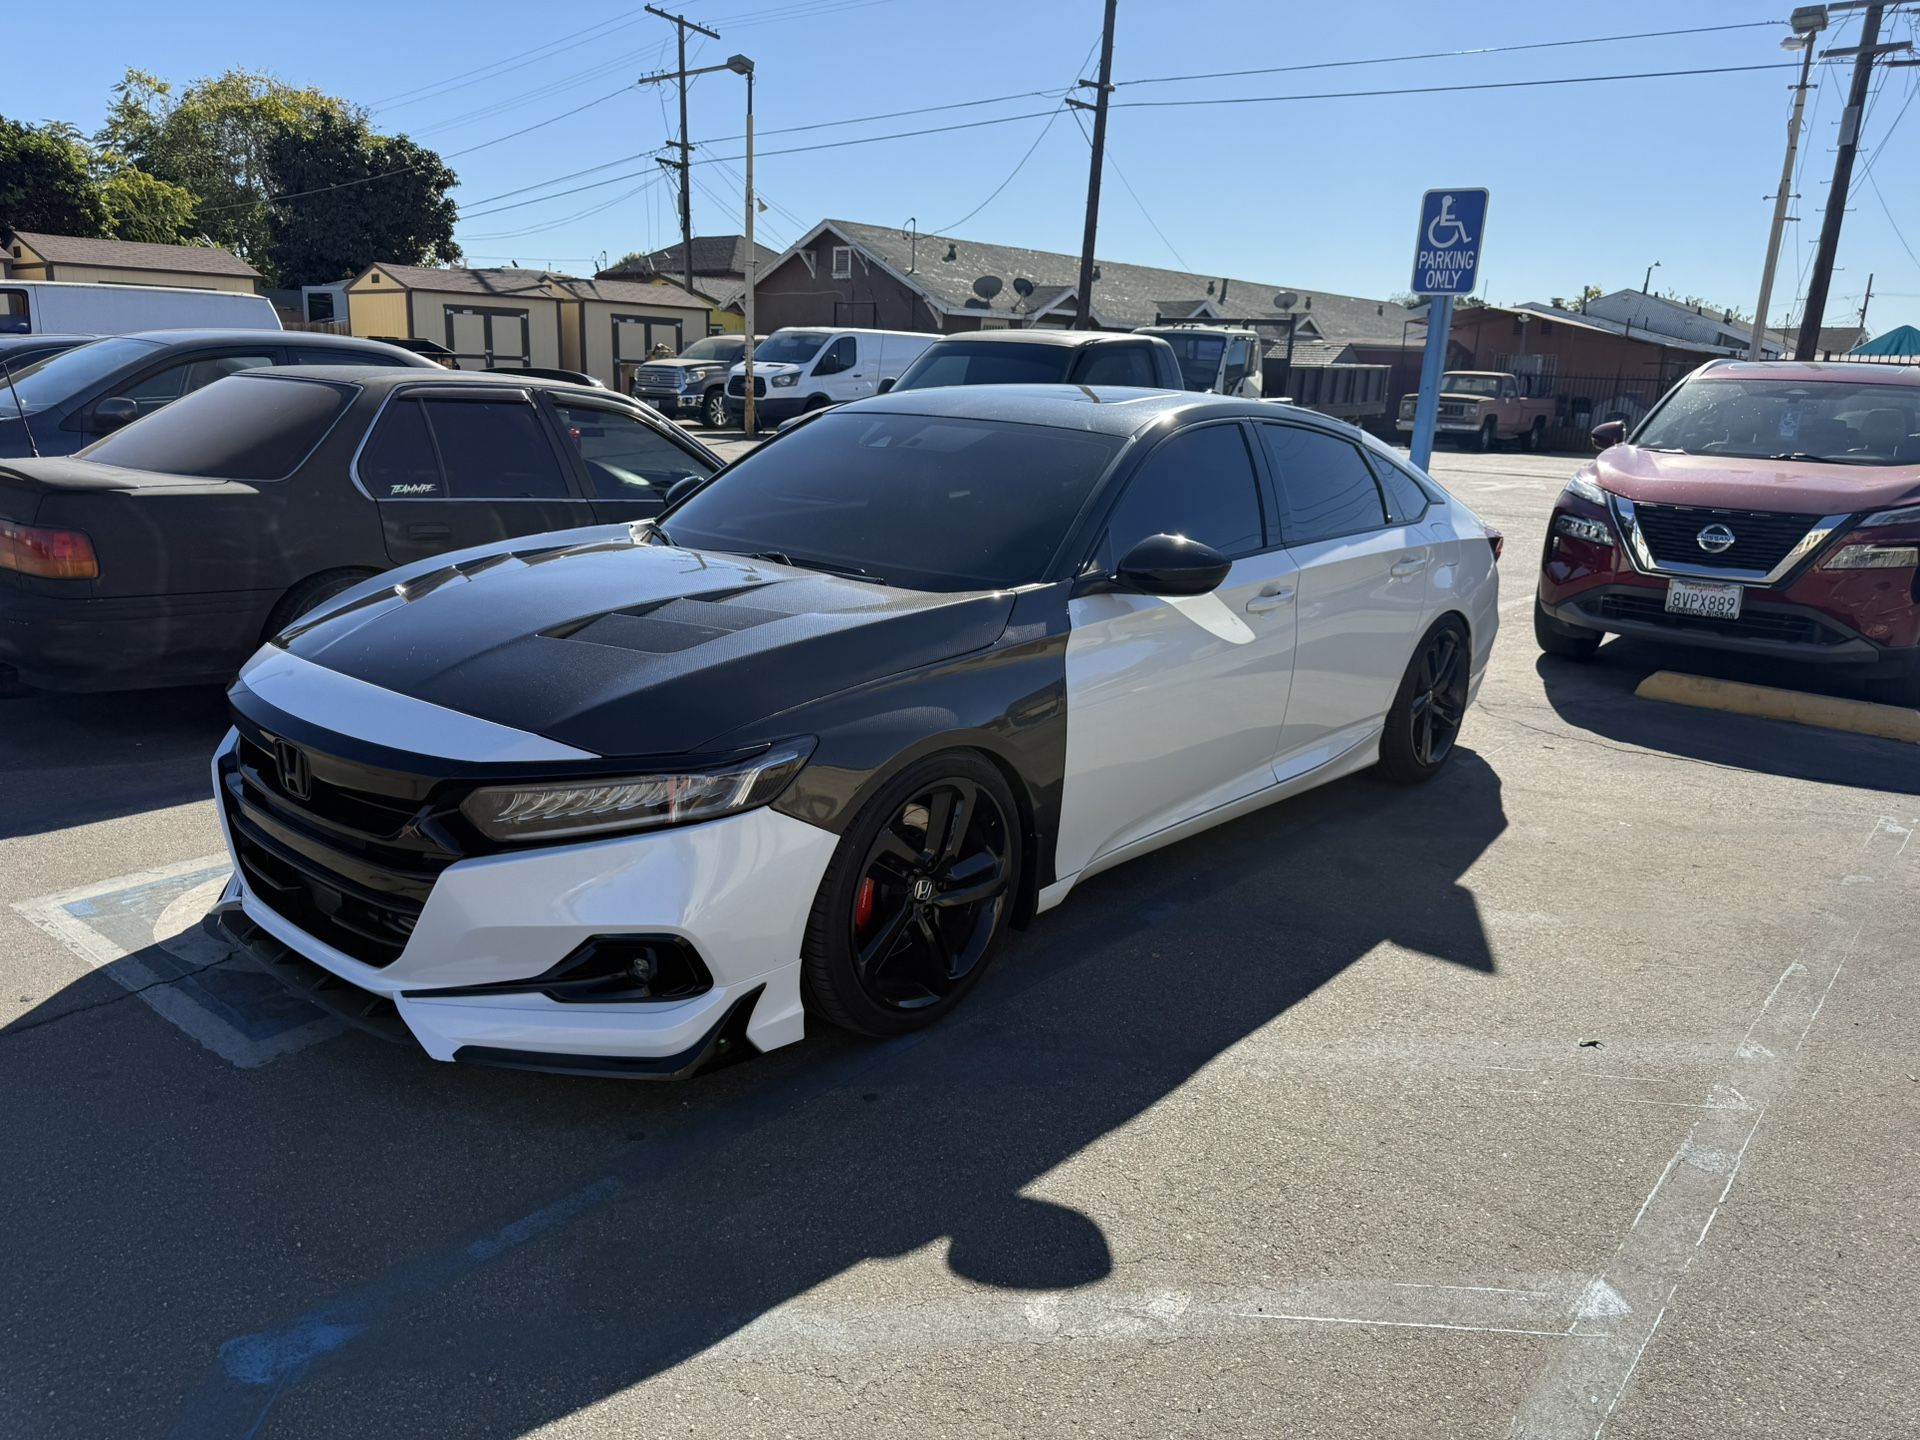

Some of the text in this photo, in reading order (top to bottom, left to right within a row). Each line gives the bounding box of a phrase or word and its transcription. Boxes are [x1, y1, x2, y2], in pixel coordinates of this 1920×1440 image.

[1418, 250, 1475, 270] PARKING
[1425, 270, 1463, 289] ONLY
[1700, 533, 1731, 542] NISSAN
[1672, 591, 1736, 612] 8VPX889
[1706, 610, 1736, 619] NISSAN
